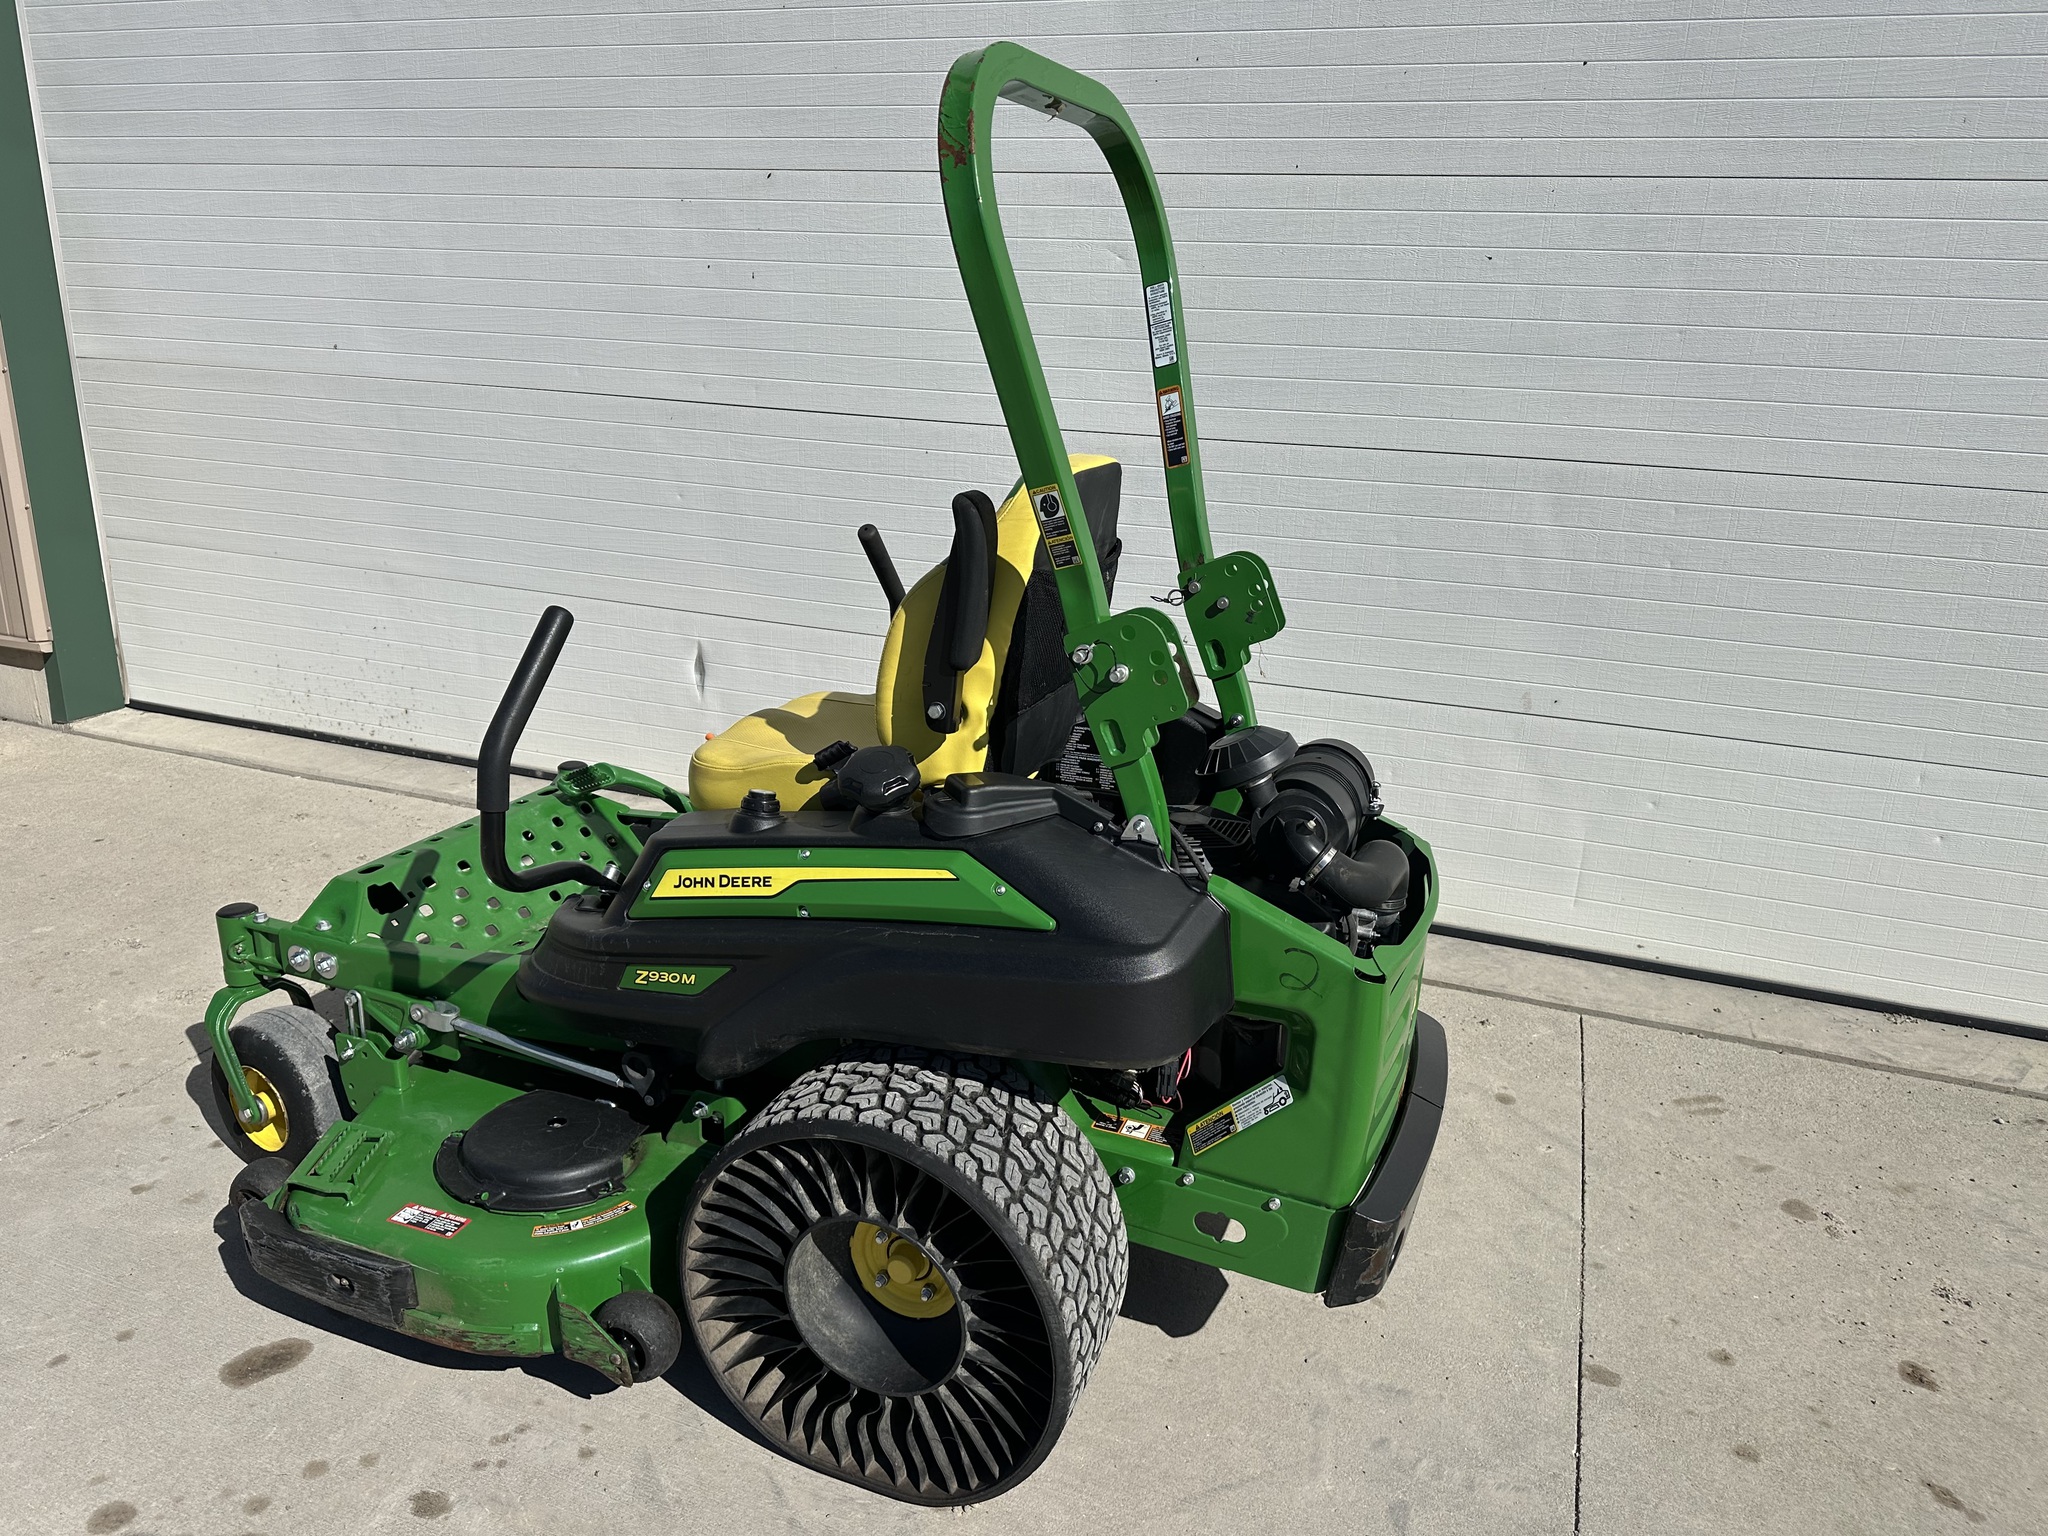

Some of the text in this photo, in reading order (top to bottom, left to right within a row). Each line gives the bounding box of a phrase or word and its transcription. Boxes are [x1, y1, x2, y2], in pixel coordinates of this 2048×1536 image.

[673, 874, 772, 889] JOHN DEERE
[635, 970, 696, 985] Z930M
